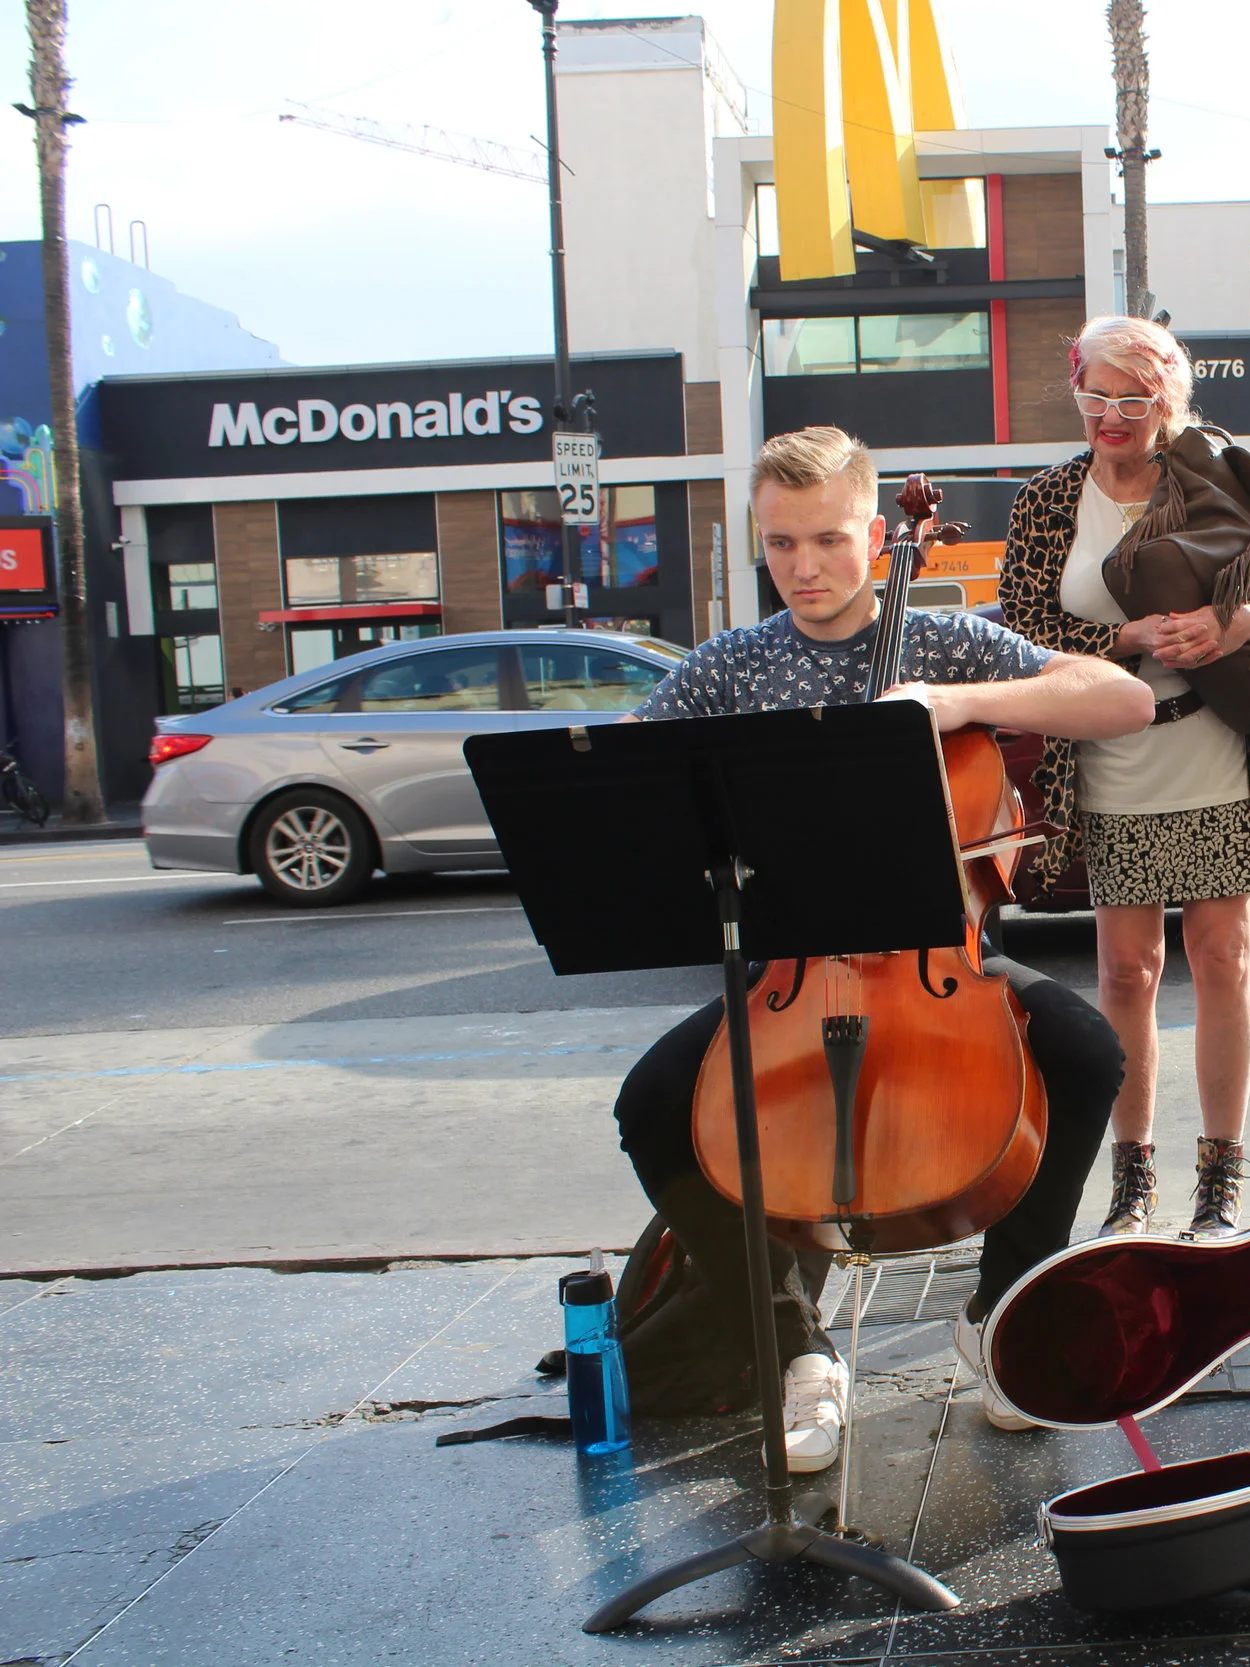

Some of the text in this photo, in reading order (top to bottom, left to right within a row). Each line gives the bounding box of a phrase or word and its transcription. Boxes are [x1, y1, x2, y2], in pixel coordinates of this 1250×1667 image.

[1194, 359, 1245, 379] 6776
[208, 390, 544, 447] McDonald's
[556, 442, 595, 457] SPEED
[560, 463, 592, 477] LIMIT
[560, 483, 595, 516] 25
[941, 560, 969, 572] 7416
